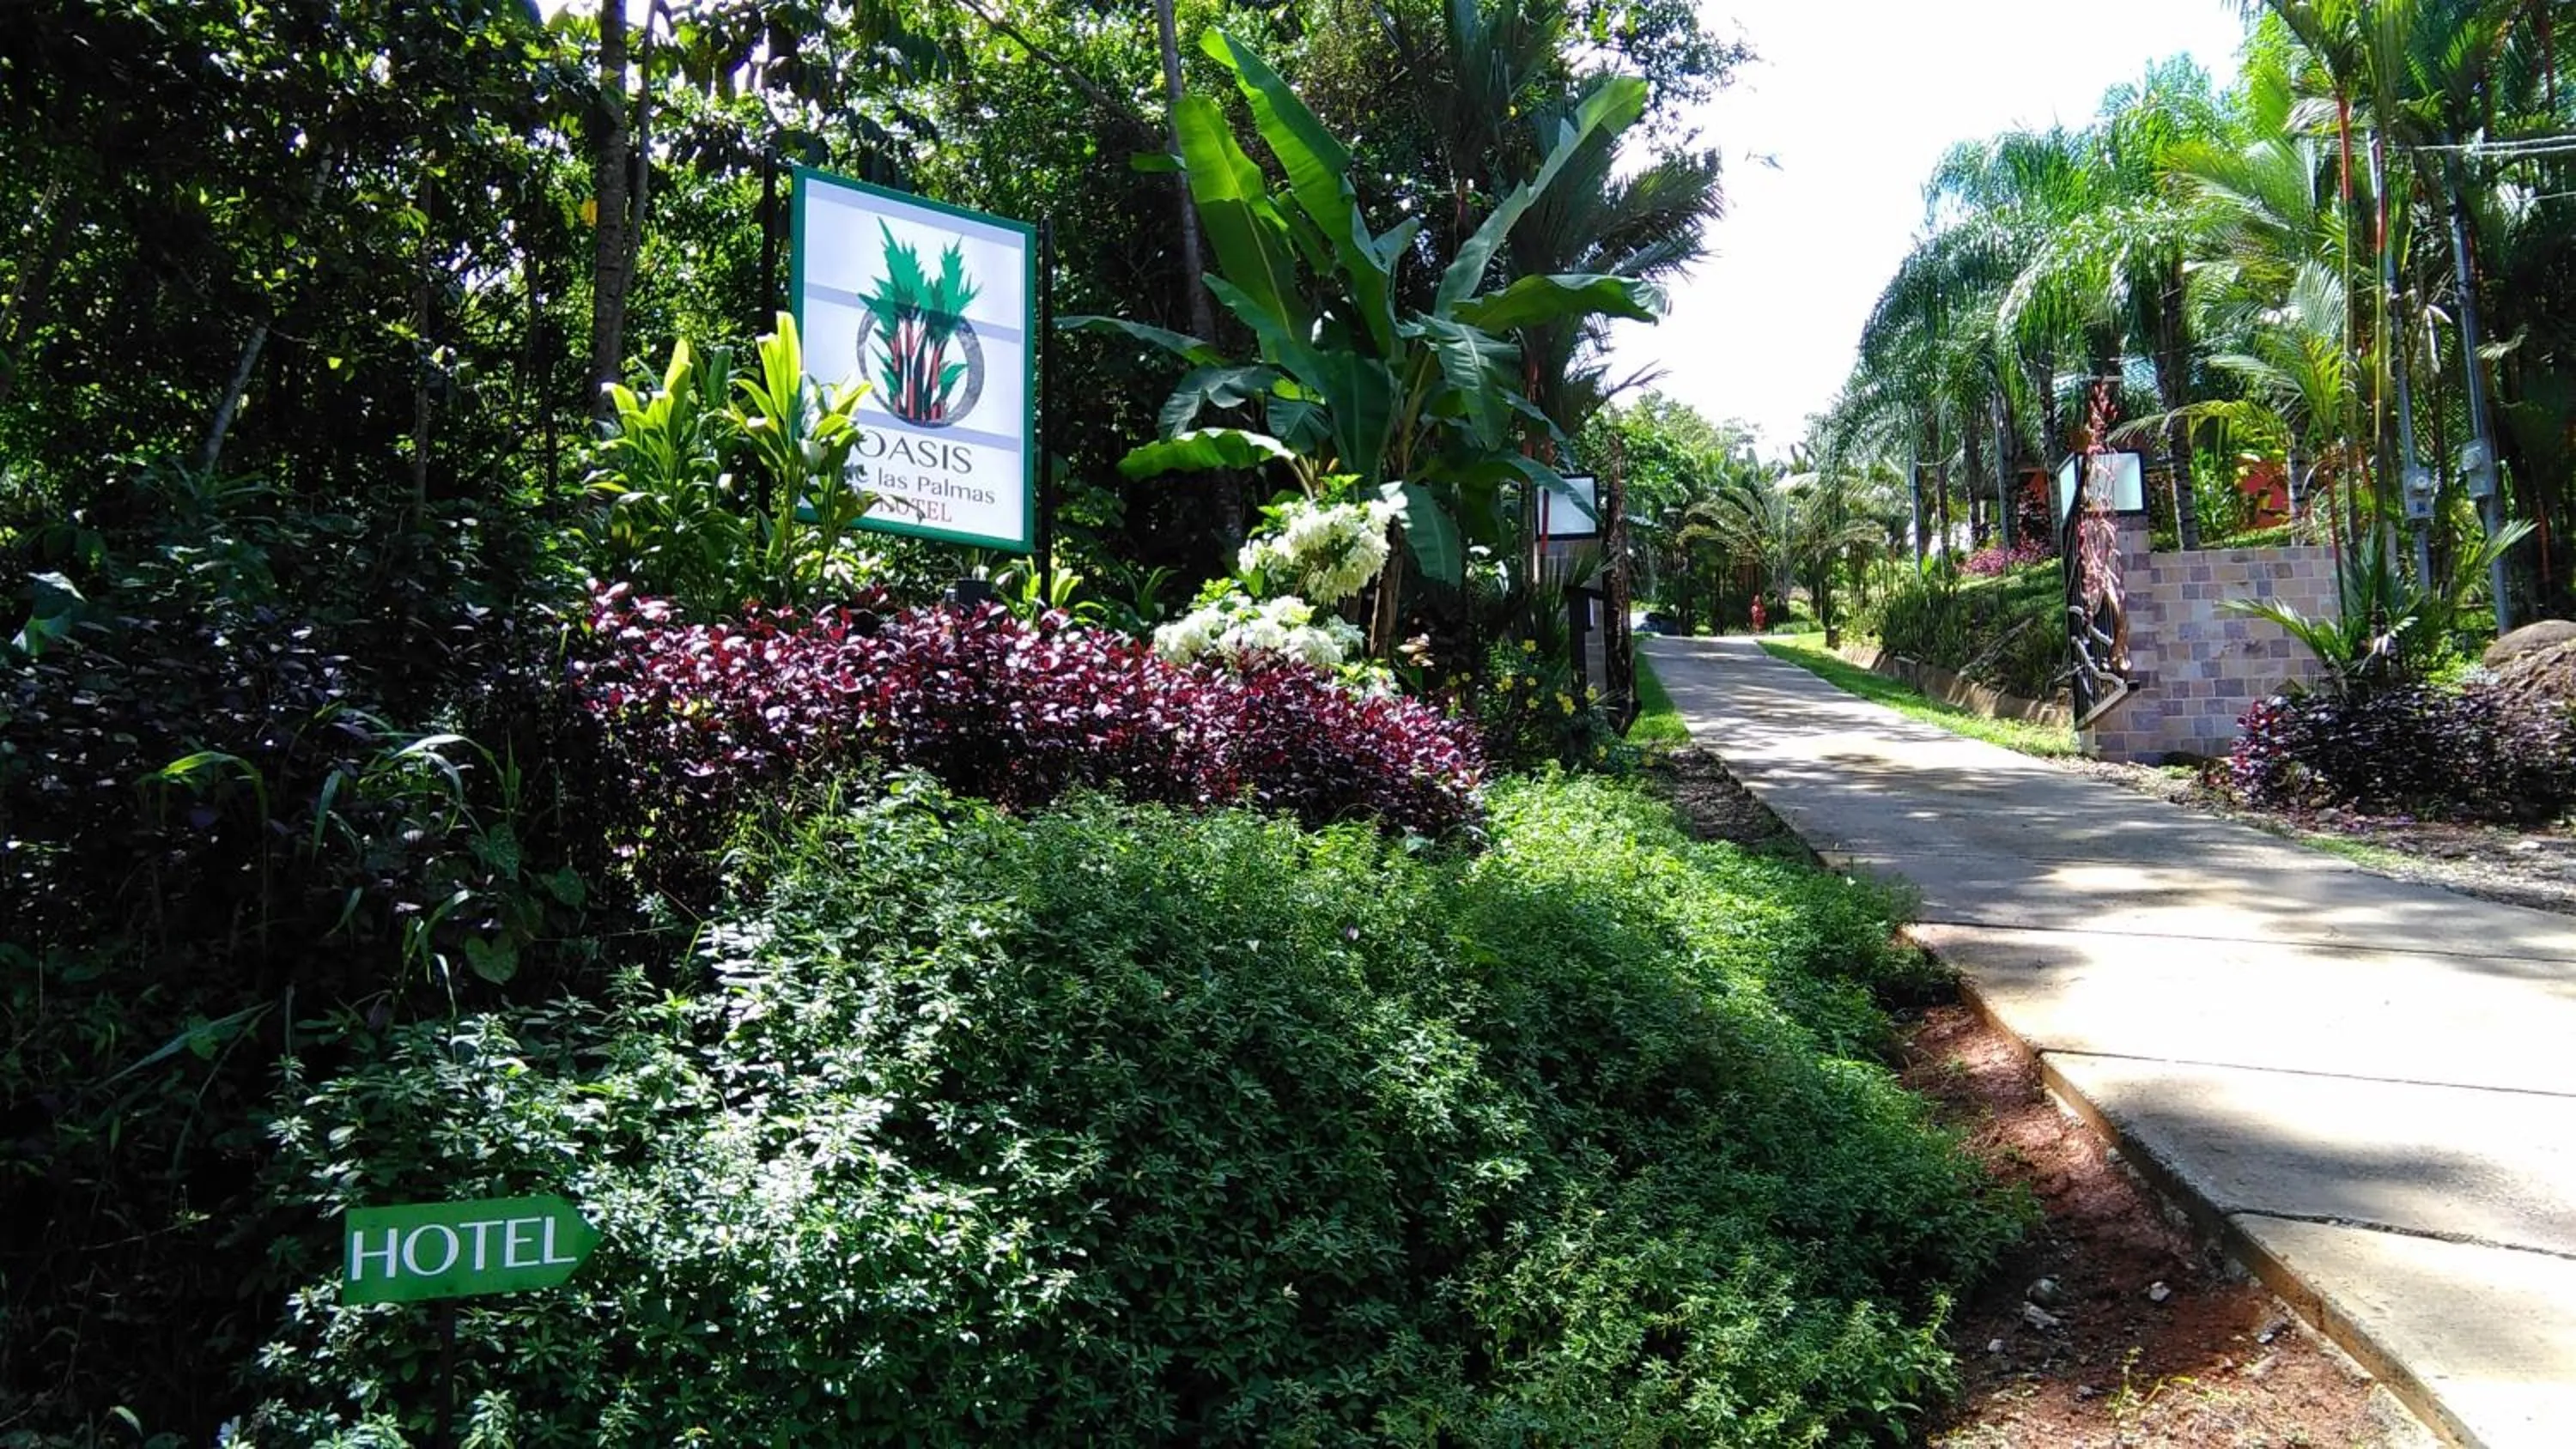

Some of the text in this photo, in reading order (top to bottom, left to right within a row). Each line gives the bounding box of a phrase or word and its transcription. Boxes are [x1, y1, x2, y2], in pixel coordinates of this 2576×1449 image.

[854, 429, 973, 474] OASIS
[878, 467, 908, 489] las
[918, 476, 996, 505] Palmas
[350, 1216, 578, 1281] HOTEL
